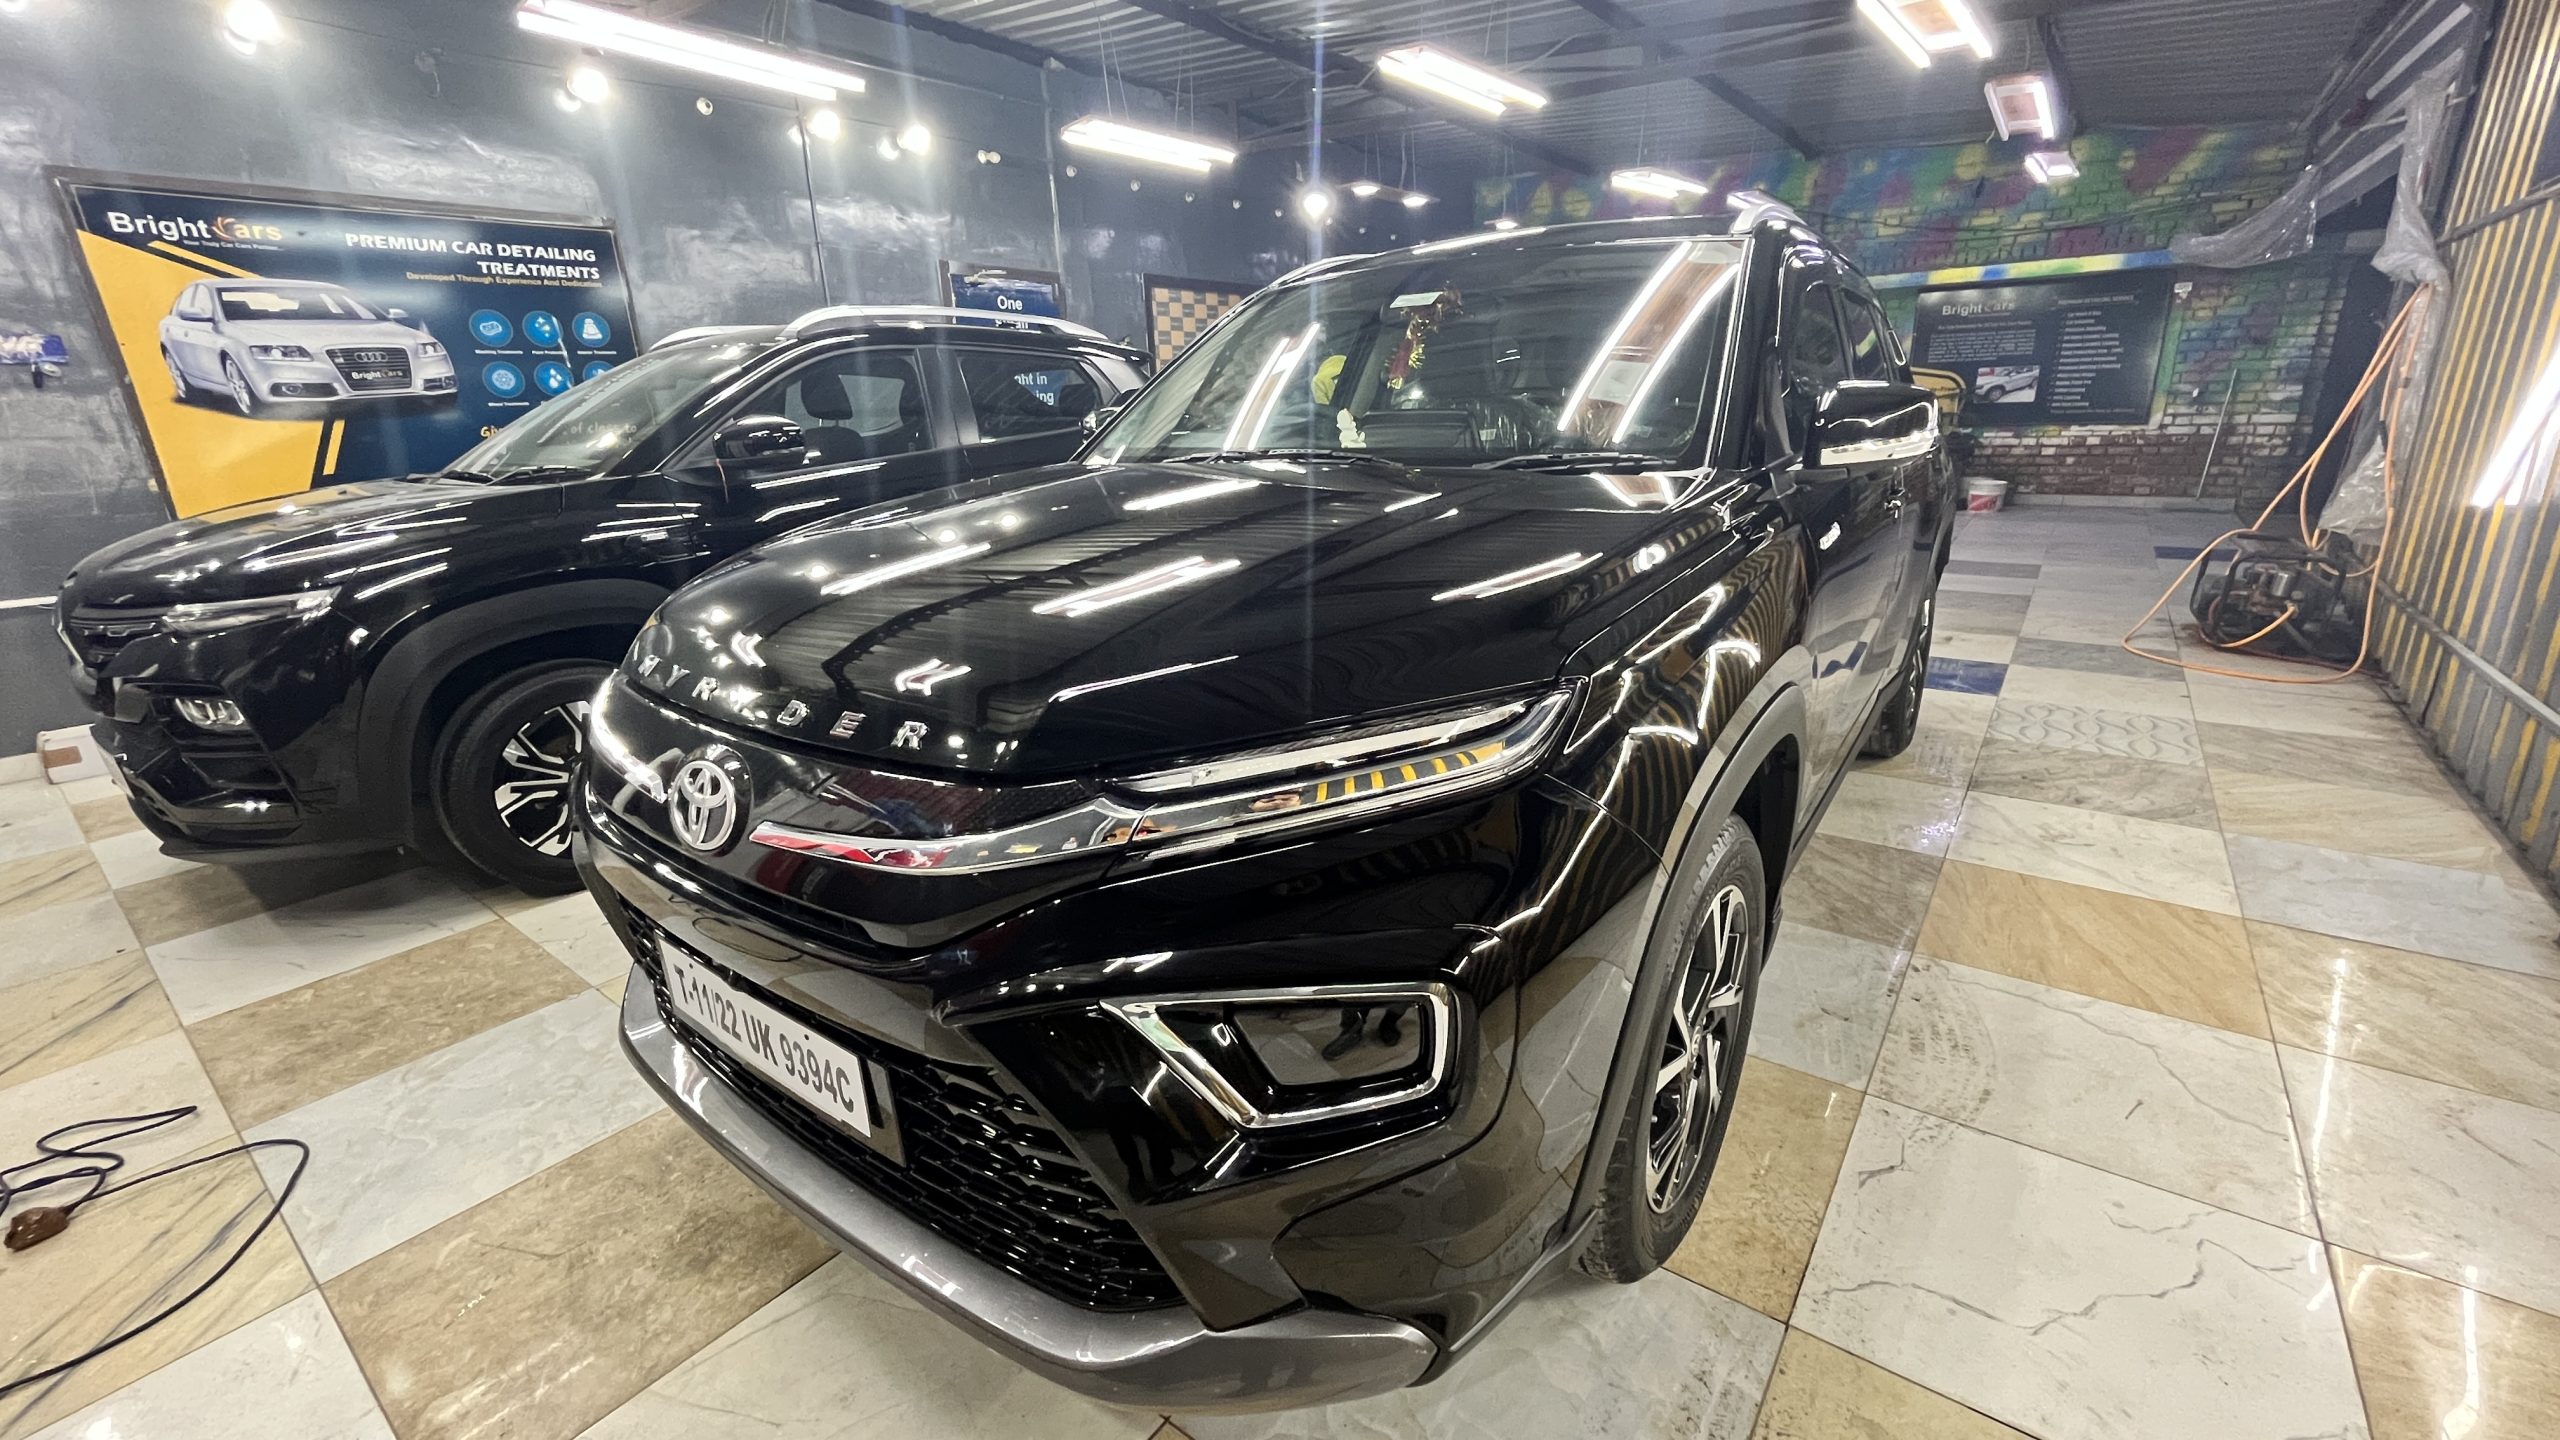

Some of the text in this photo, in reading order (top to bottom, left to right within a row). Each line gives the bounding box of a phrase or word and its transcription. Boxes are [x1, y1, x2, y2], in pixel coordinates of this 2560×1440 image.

[345, 233, 596, 262] PREMIUM CAR DETAILING
[476, 261, 600, 280] TREATMENTS
[997, 295, 1023, 311] One
[1036, 371, 1048, 385] in
[673, 963, 855, 1113] T-11/22 UK 9394C
